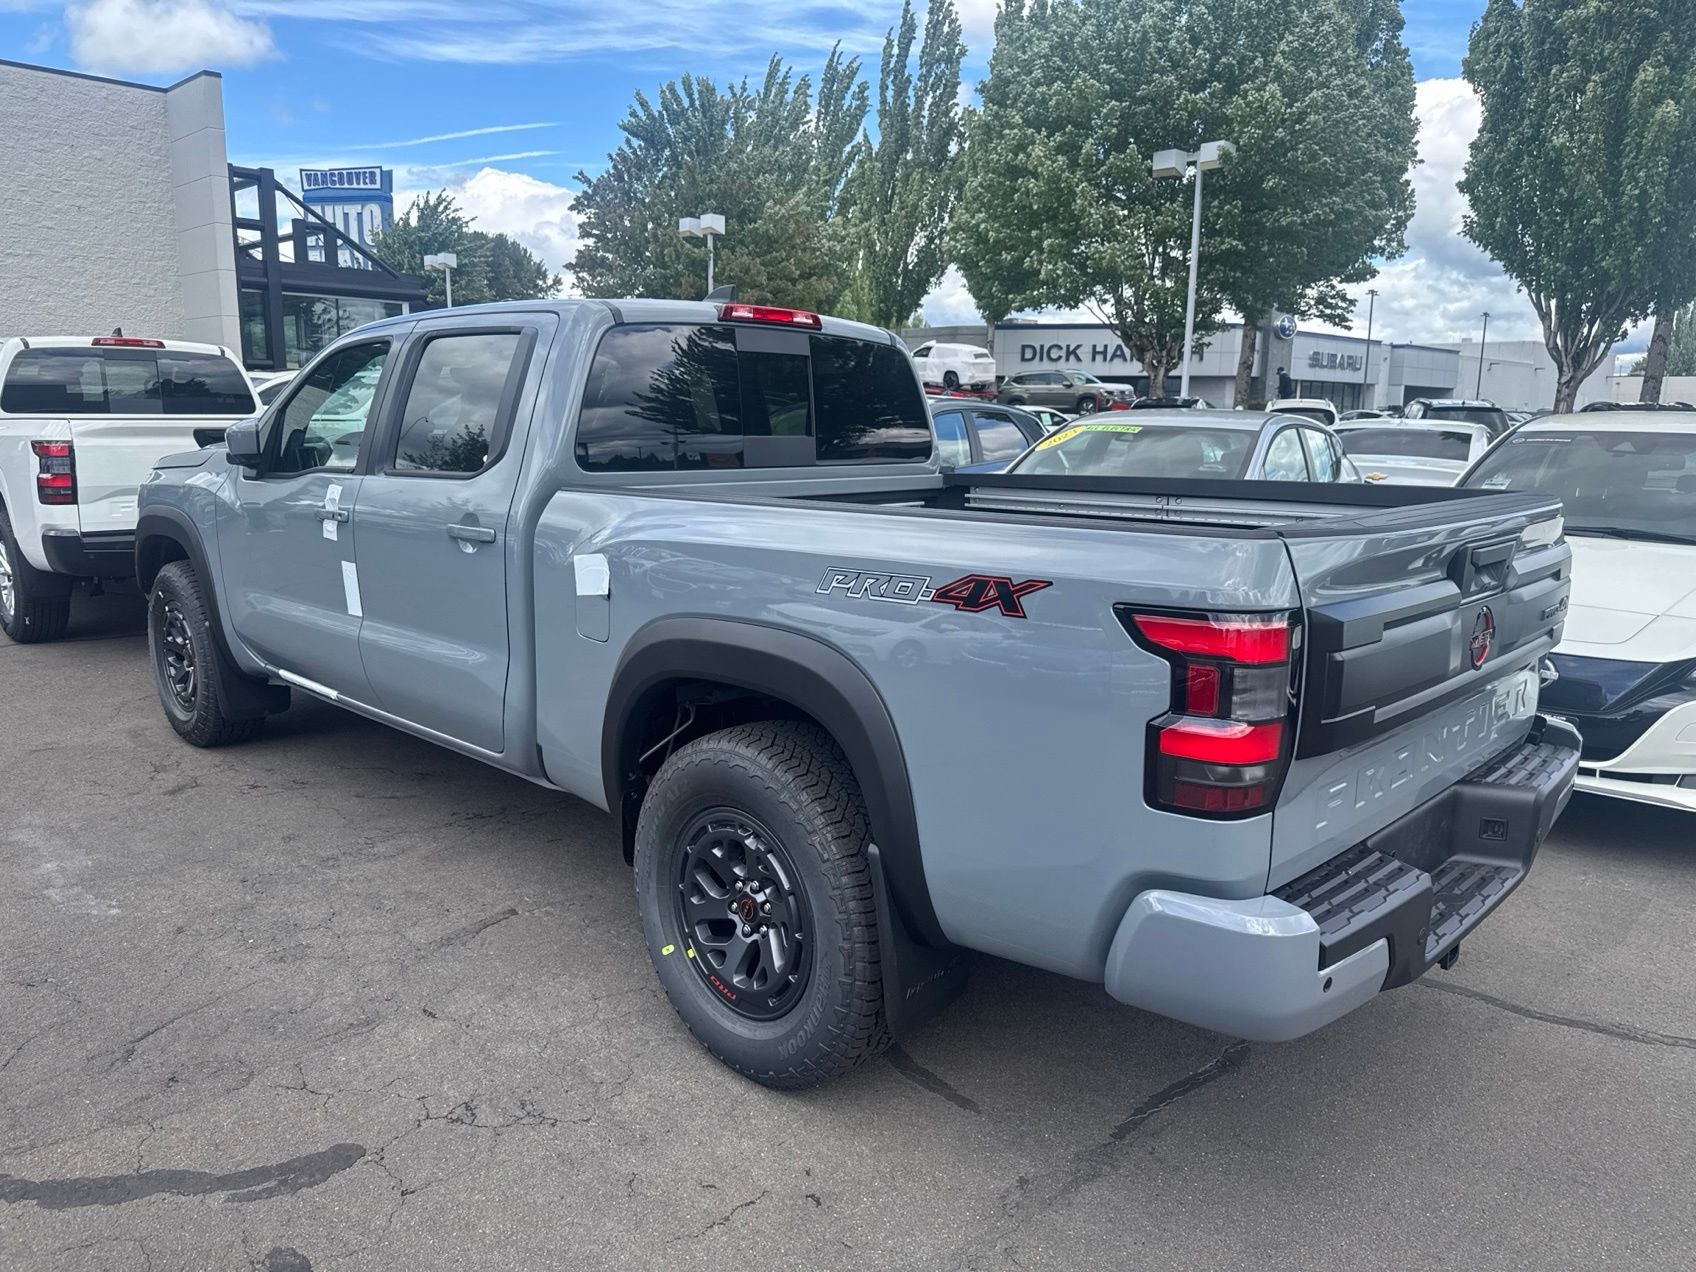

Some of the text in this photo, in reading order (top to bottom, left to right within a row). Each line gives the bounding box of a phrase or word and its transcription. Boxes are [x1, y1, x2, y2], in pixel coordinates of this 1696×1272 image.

[305, 170, 377, 187] VANCOUVER
[1020, 343, 1083, 363] DICK
[1308, 351, 1362, 371] SUBARU
